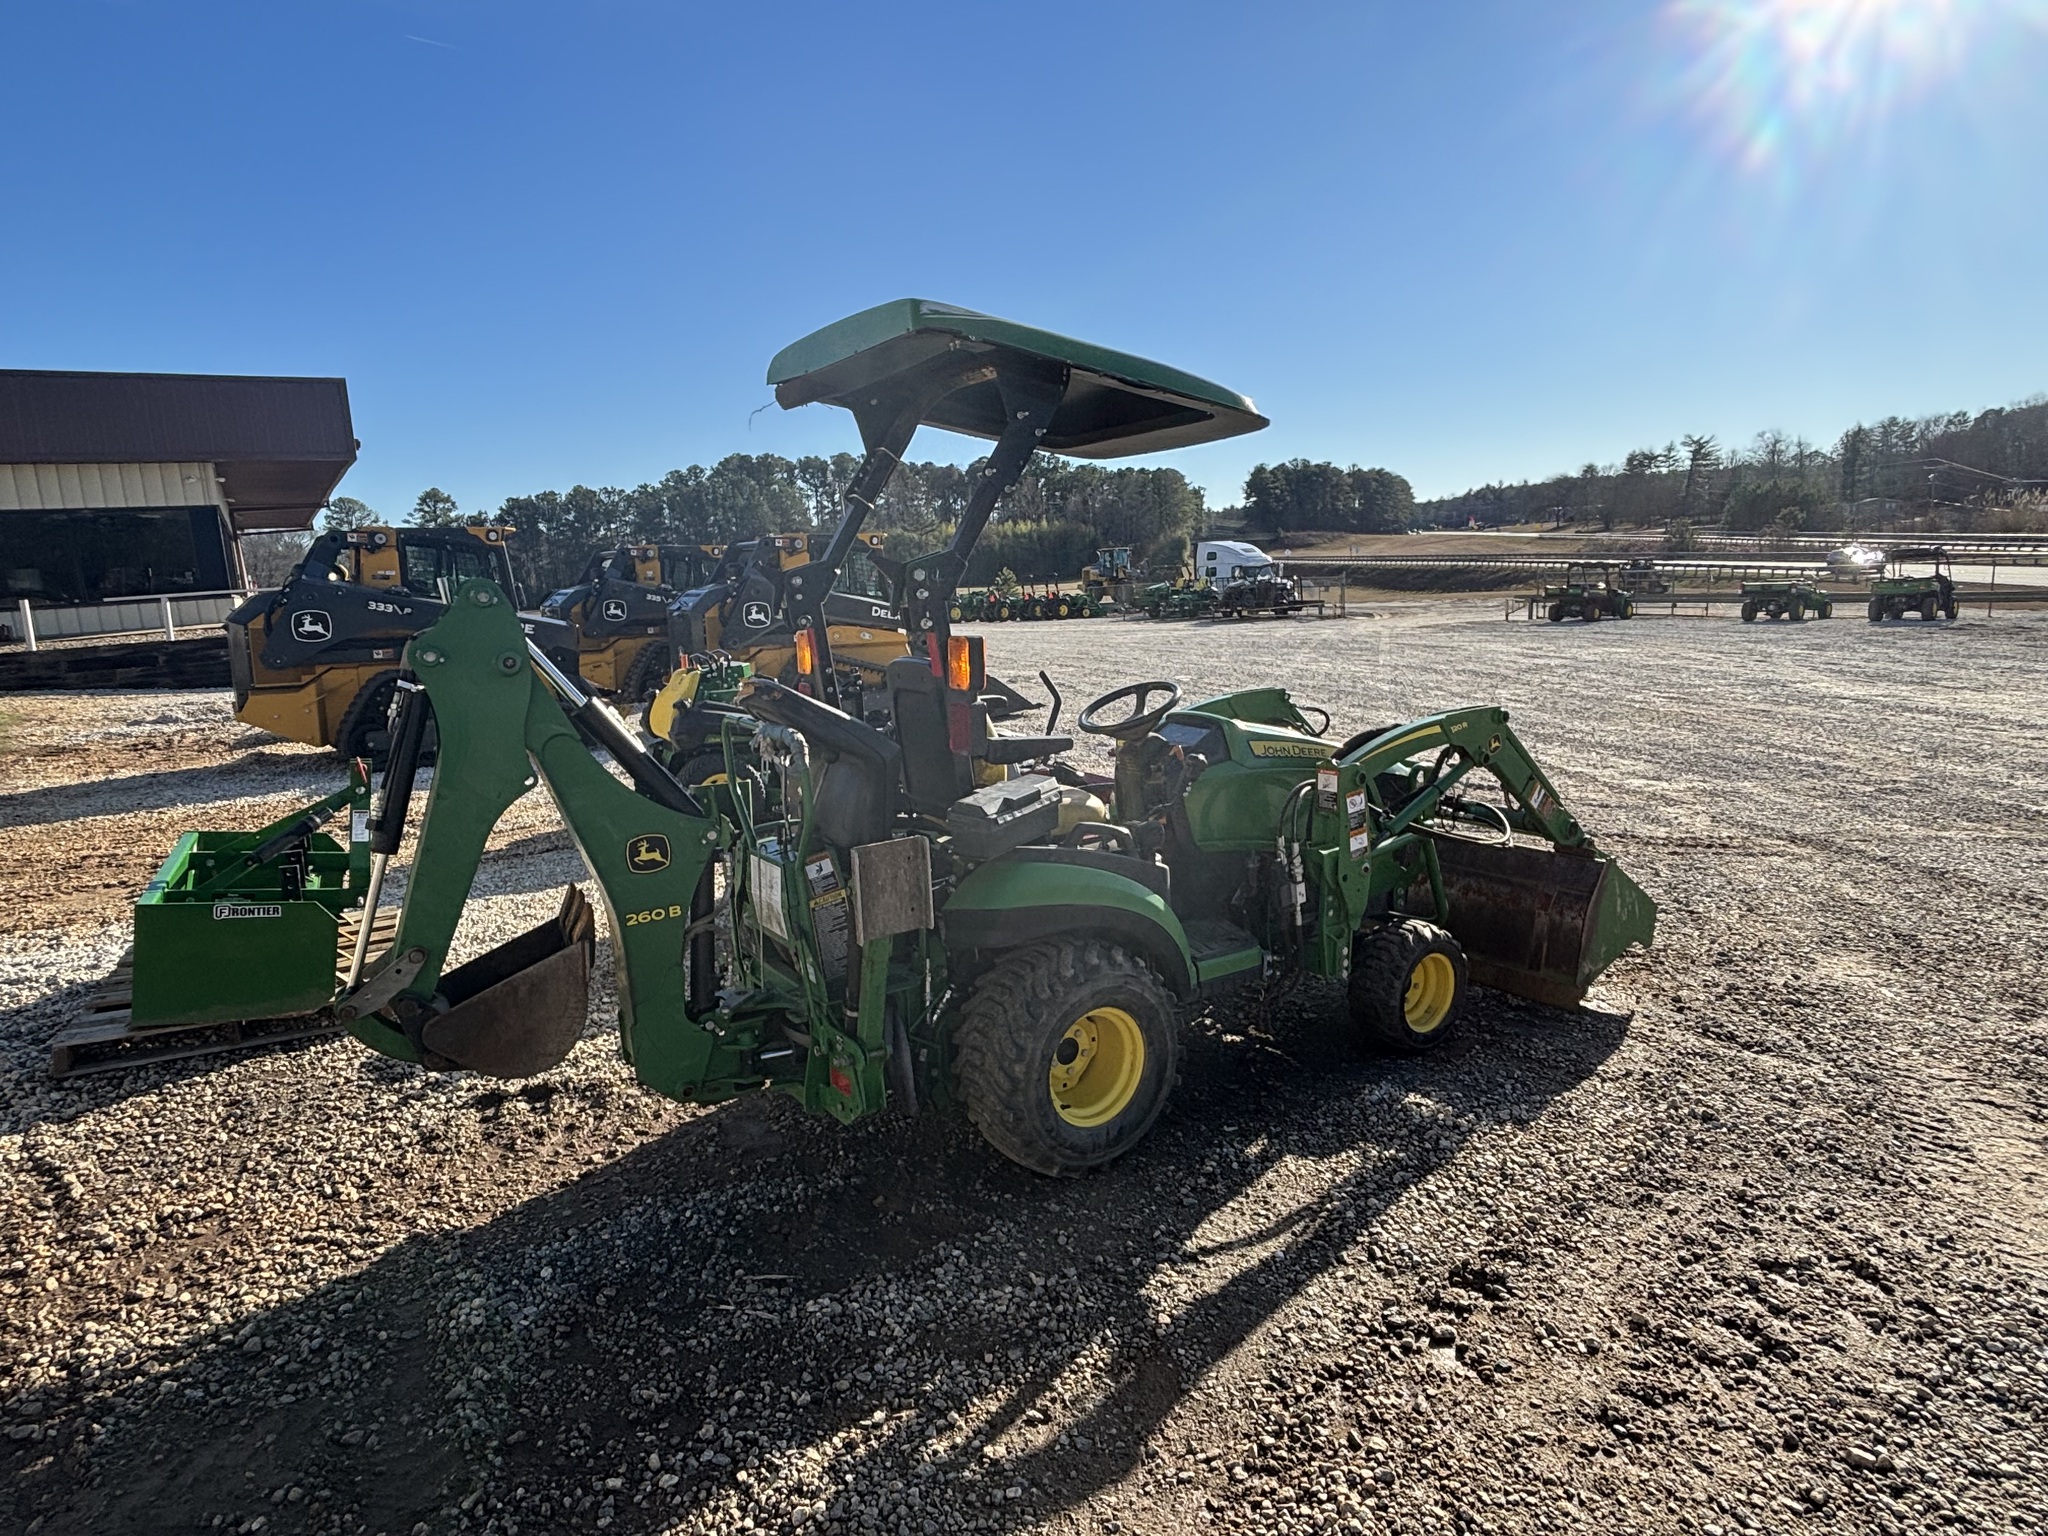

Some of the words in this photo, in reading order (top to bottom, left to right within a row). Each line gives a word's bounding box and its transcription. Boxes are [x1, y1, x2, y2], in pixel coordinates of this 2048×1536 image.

[1261, 744, 1290, 756] JOHN
[1292, 744, 1327, 757] DEERE
[215, 905, 280, 919] FRONTIER
[625, 908, 666, 927] 260
[668, 905, 682, 918] B
